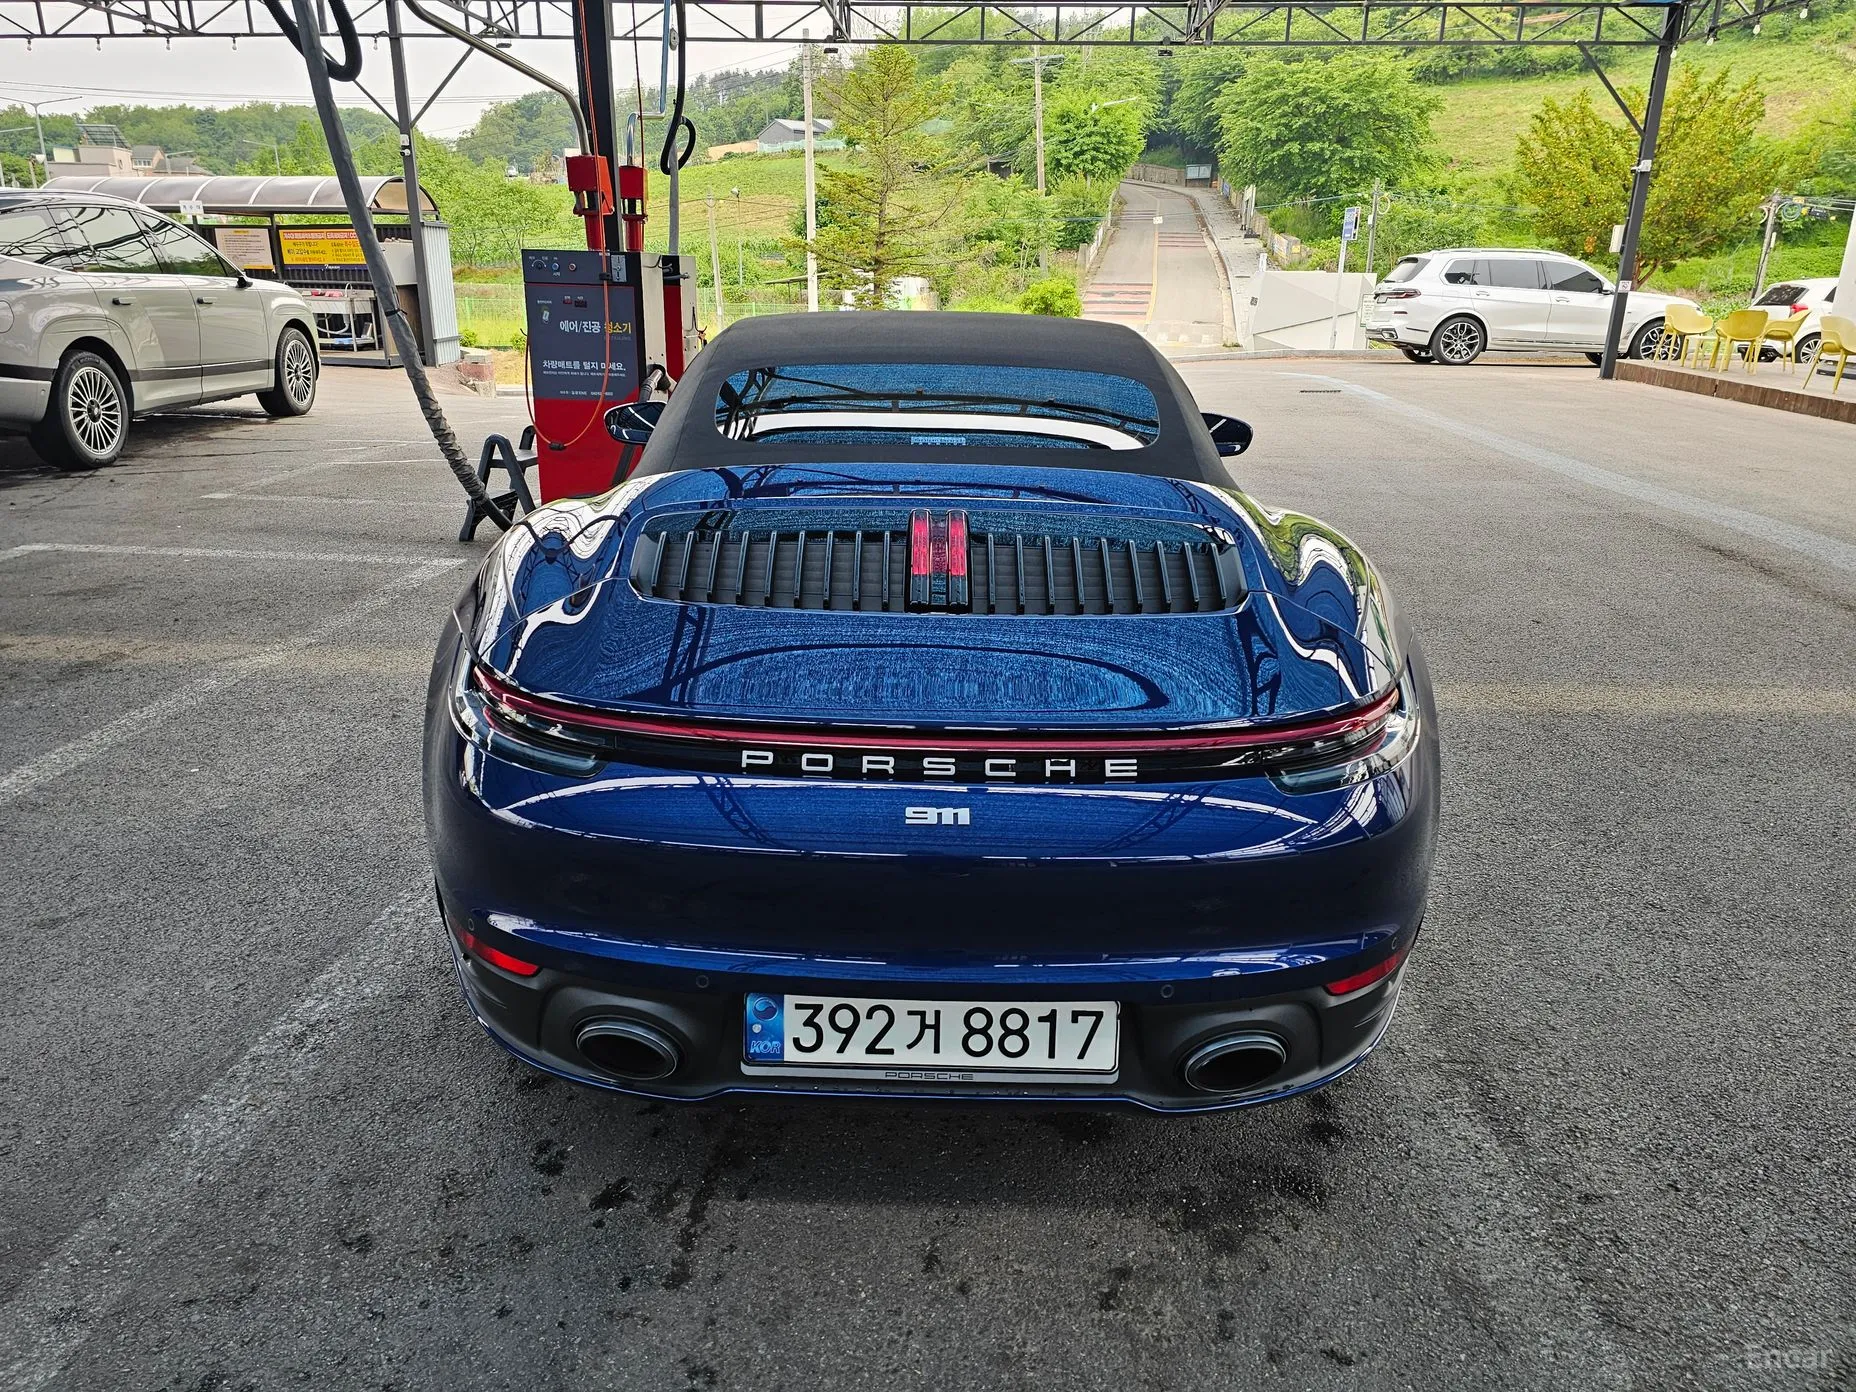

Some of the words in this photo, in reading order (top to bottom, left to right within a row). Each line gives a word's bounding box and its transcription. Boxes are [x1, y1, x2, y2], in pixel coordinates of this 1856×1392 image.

[560, 320, 601, 333] 에어/진공
[543, 360, 581, 370] 차량매트를
[582, 361, 599, 370] 털지
[741, 750, 1138, 777] PORSCHE
[905, 807, 970, 825] 911
[792, 1003, 941, 1055] 392거
[961, 1006, 1104, 1060] 8817
[750, 1041, 781, 1053] KOR
[885, 1072, 973, 1080] PORSCHE
